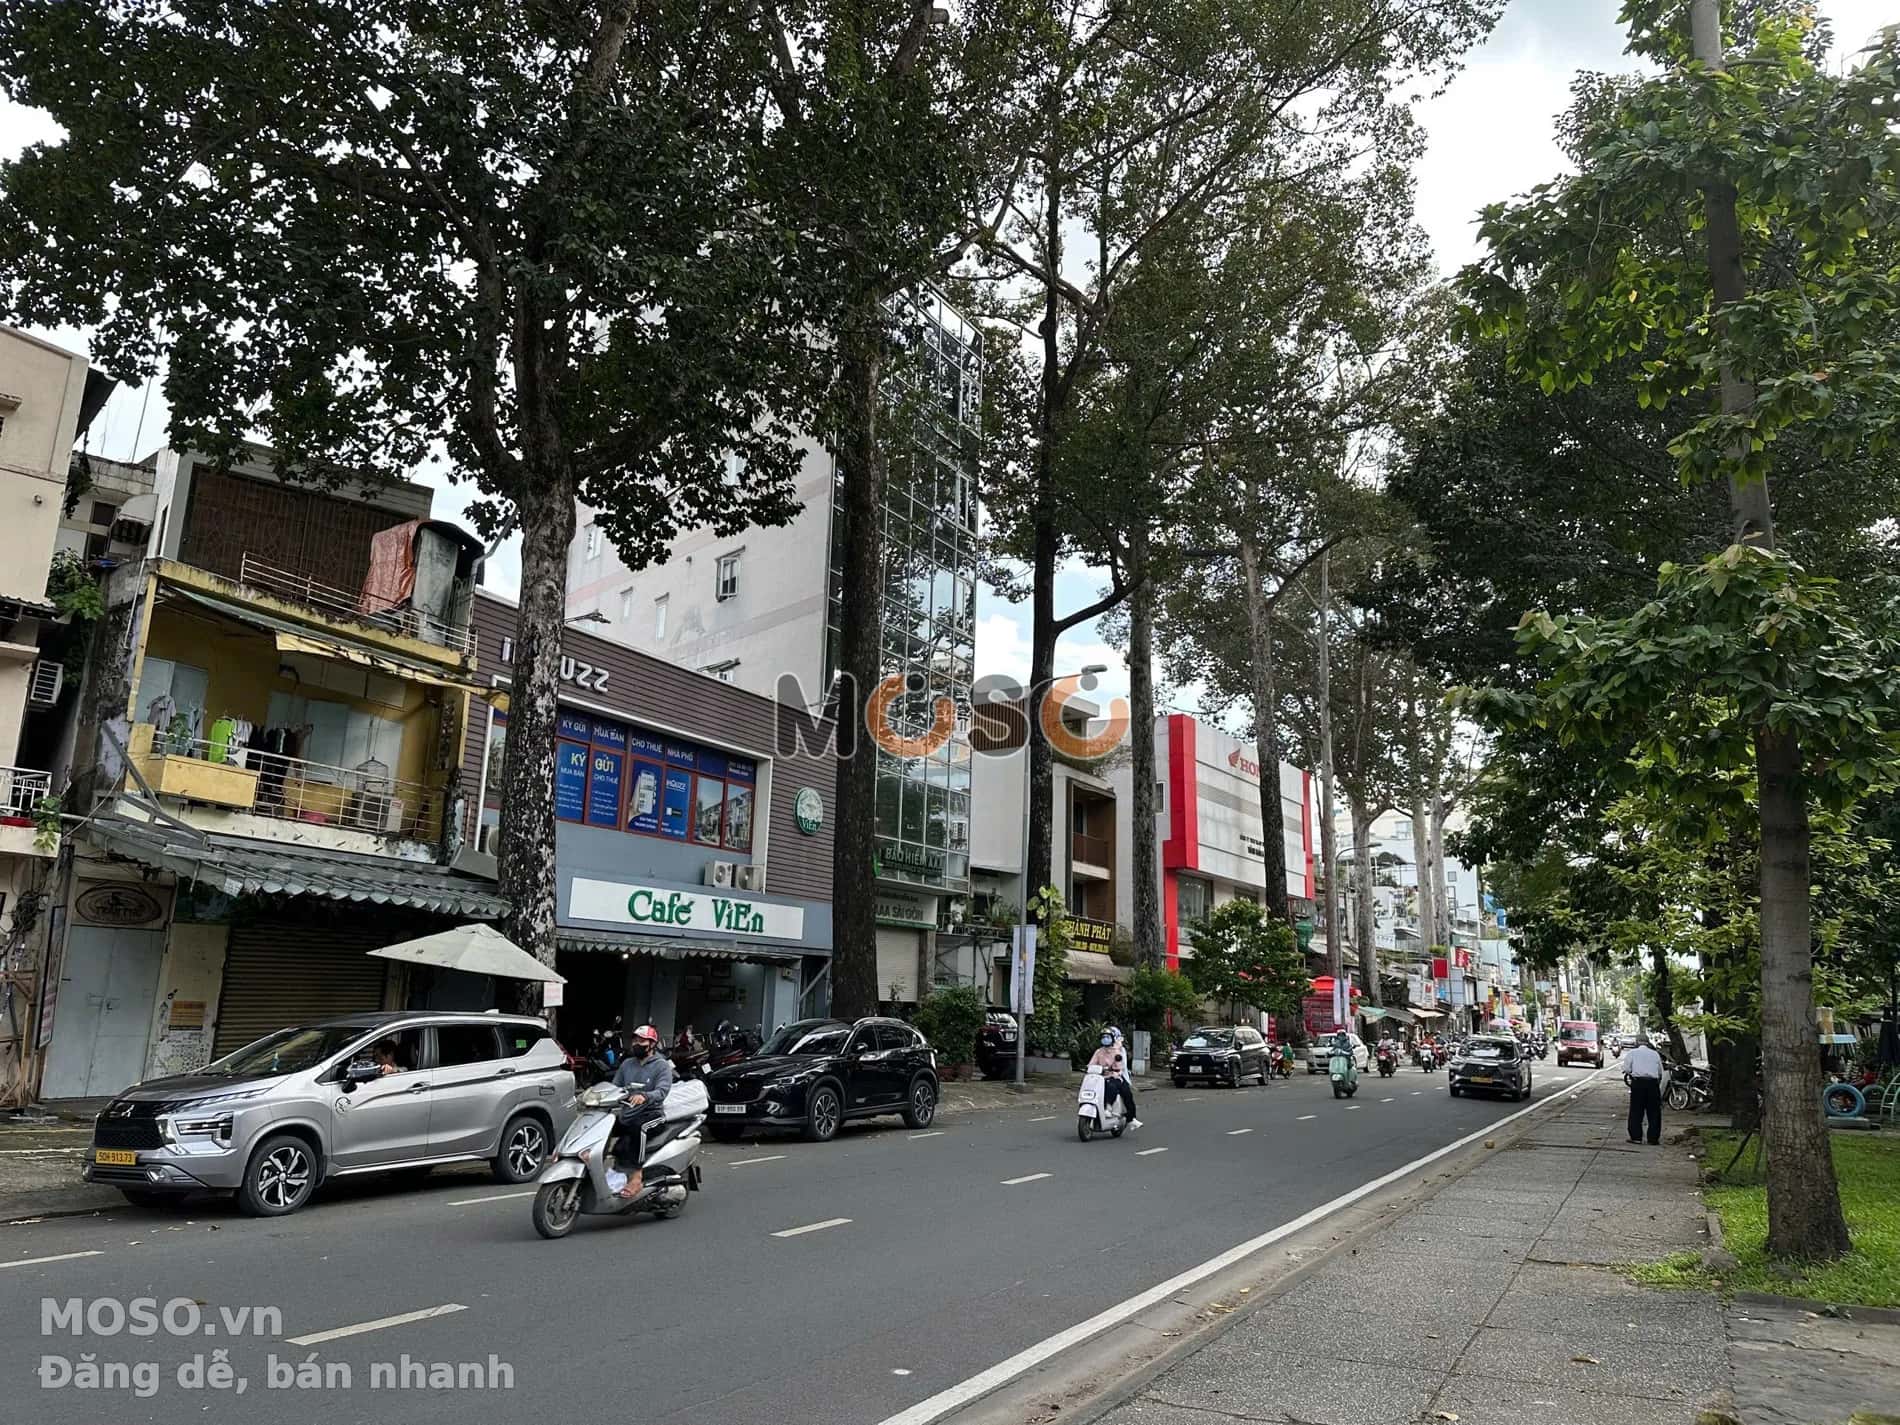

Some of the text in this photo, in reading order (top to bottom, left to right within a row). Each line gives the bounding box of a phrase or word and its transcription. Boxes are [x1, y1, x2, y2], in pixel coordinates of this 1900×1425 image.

[593, 727, 609, 738] MUA
[631, 737, 646, 748] CHO
[571, 752, 614, 773] KÝ GỬI
[628, 890, 764, 933] Café ViEn
